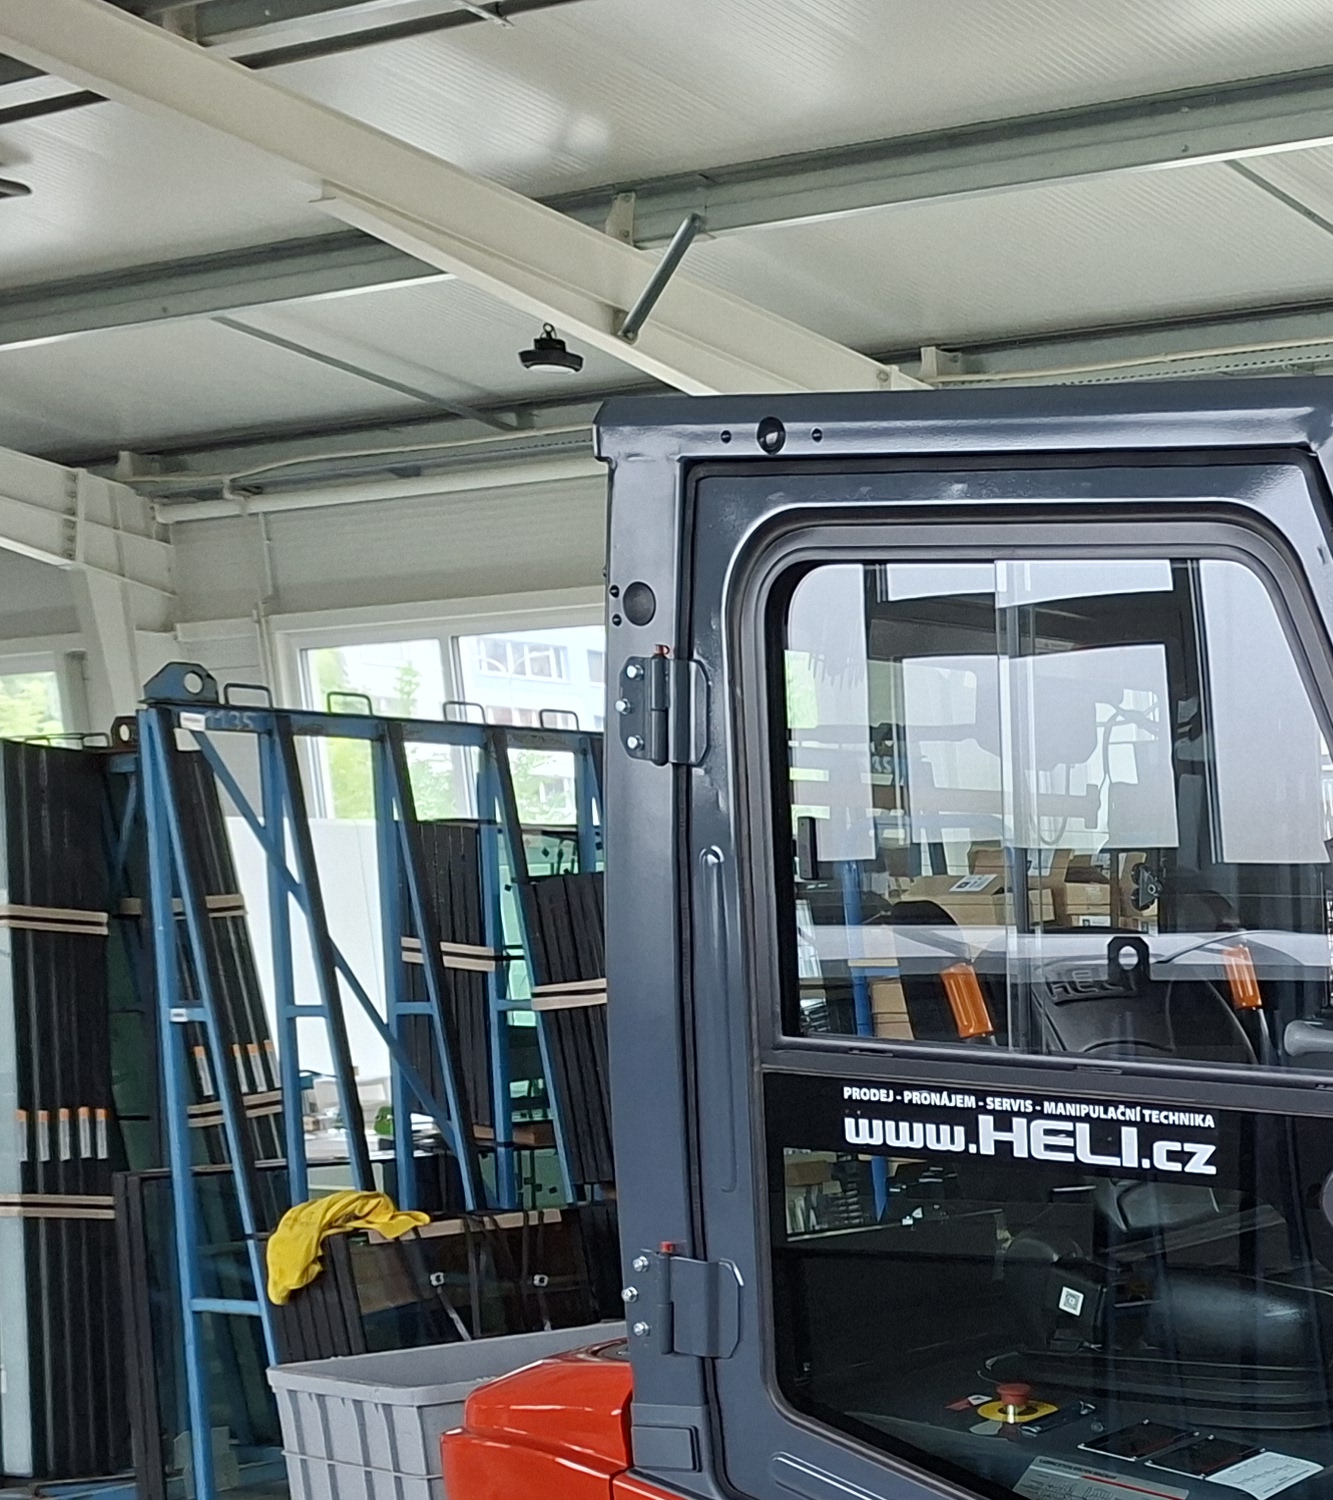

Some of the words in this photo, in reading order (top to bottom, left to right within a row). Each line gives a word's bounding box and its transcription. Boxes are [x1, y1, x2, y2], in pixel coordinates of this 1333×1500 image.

[843, 1087, 894, 1102] PRODEJ
[903, 1090, 976, 1109] PRONÁJEM
[986, 1097, 1034, 1113] SERVIS
[1043, 1102, 1142, 1122] MANIPULAČNÍ
[1143, 1108, 1215, 1128] TECHNIKA
[844, 1114, 1217, 1175] www.HELI.cz
